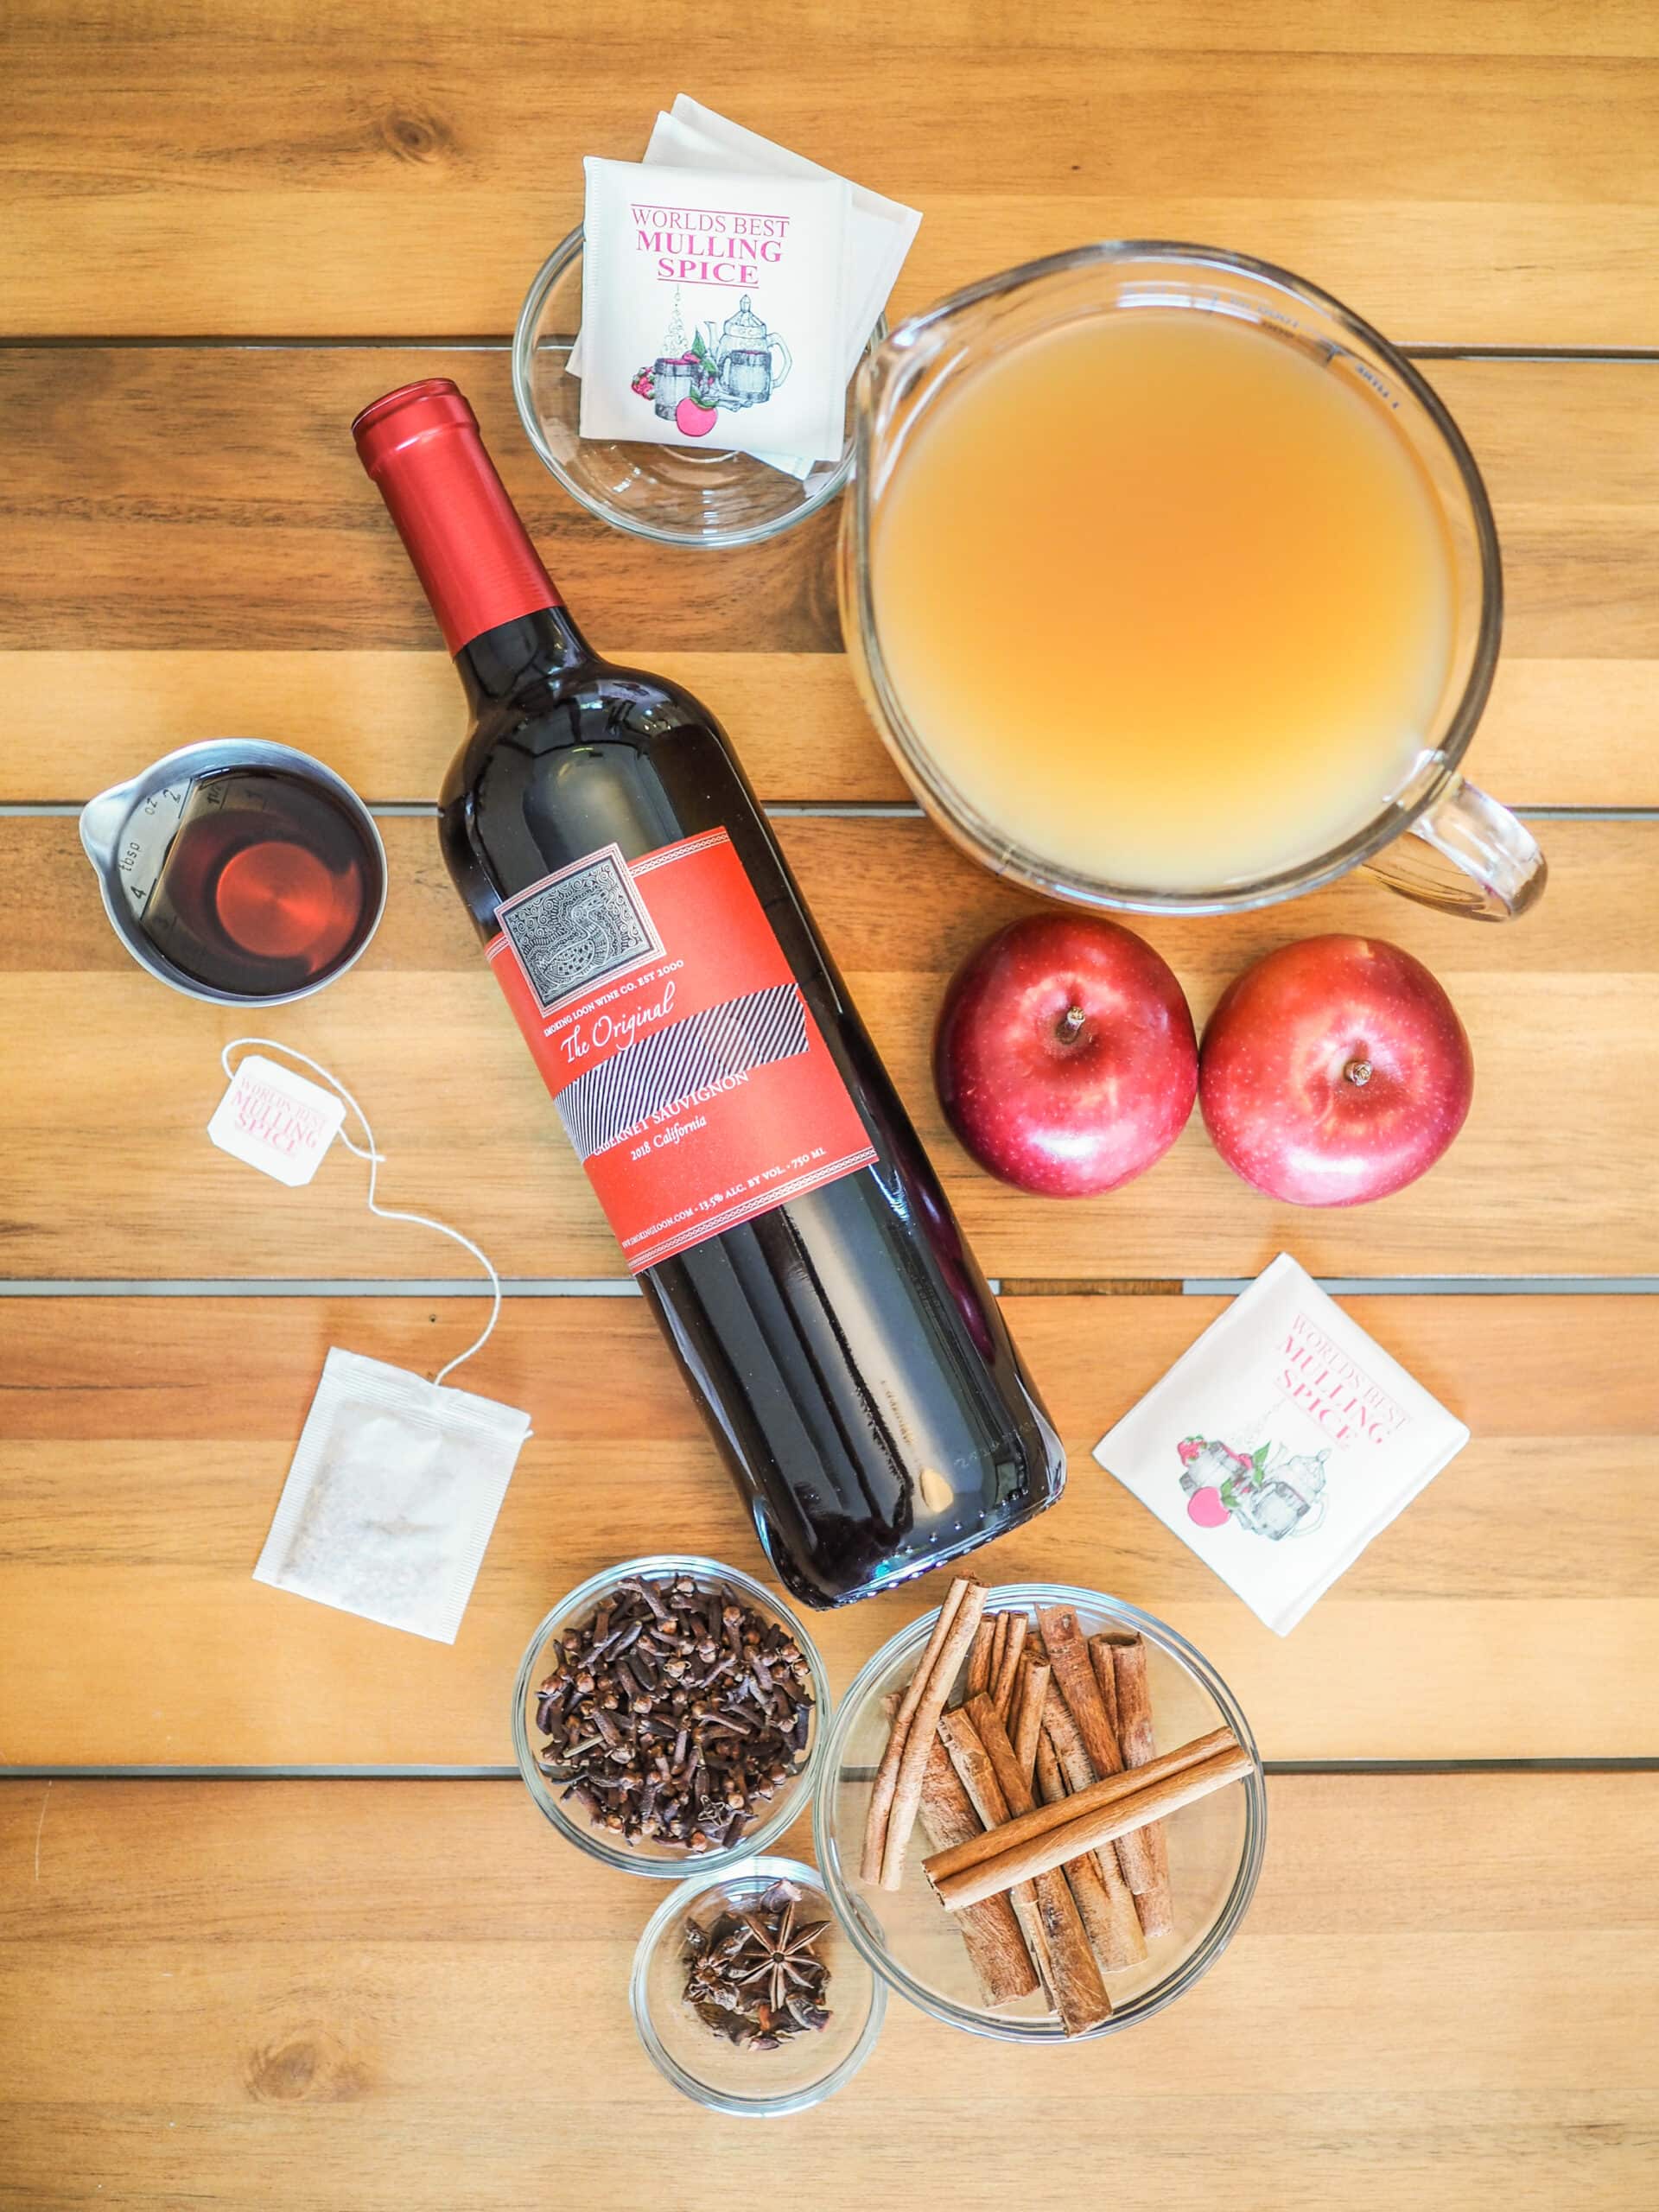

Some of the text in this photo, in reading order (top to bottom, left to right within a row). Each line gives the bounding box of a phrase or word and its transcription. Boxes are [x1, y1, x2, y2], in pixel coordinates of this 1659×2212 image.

[632, 209, 791, 238] WORLDS BEST
[636, 231, 782, 262] MULLING
[657, 257, 759, 283] SPICE
[162, 788, 181, 804] 2
[119, 842, 141, 872] tbsp
[130, 886, 146, 899] 4
[572, 1002, 594, 1020] LOON
[594, 990, 620, 1007] WINE
[620, 982, 637, 995] CO.
[638, 971, 656, 986] EST
[657, 959, 684, 977] 2000
[561, 980, 677, 1063] The Original
[231, 1090, 317, 1148] MULLING
[652, 1070, 749, 1124] SAUVIGNON
[631, 1116, 708, 1160] 2018 California
[698, 1193, 724, 1211] 13.5%
[725, 1184, 747, 1198] ALC.
[747, 1175, 761, 1188] BY
[762, 1166, 785, 1180] VOL.
[791, 1154, 810, 1169] 750
[810, 1147, 826, 1160] ML
[1276, 1335, 1389, 1444] MULLING
[1293, 1314, 1412, 1430] WORLDS BEST
[1277, 1370, 1357, 1443] SPICE
